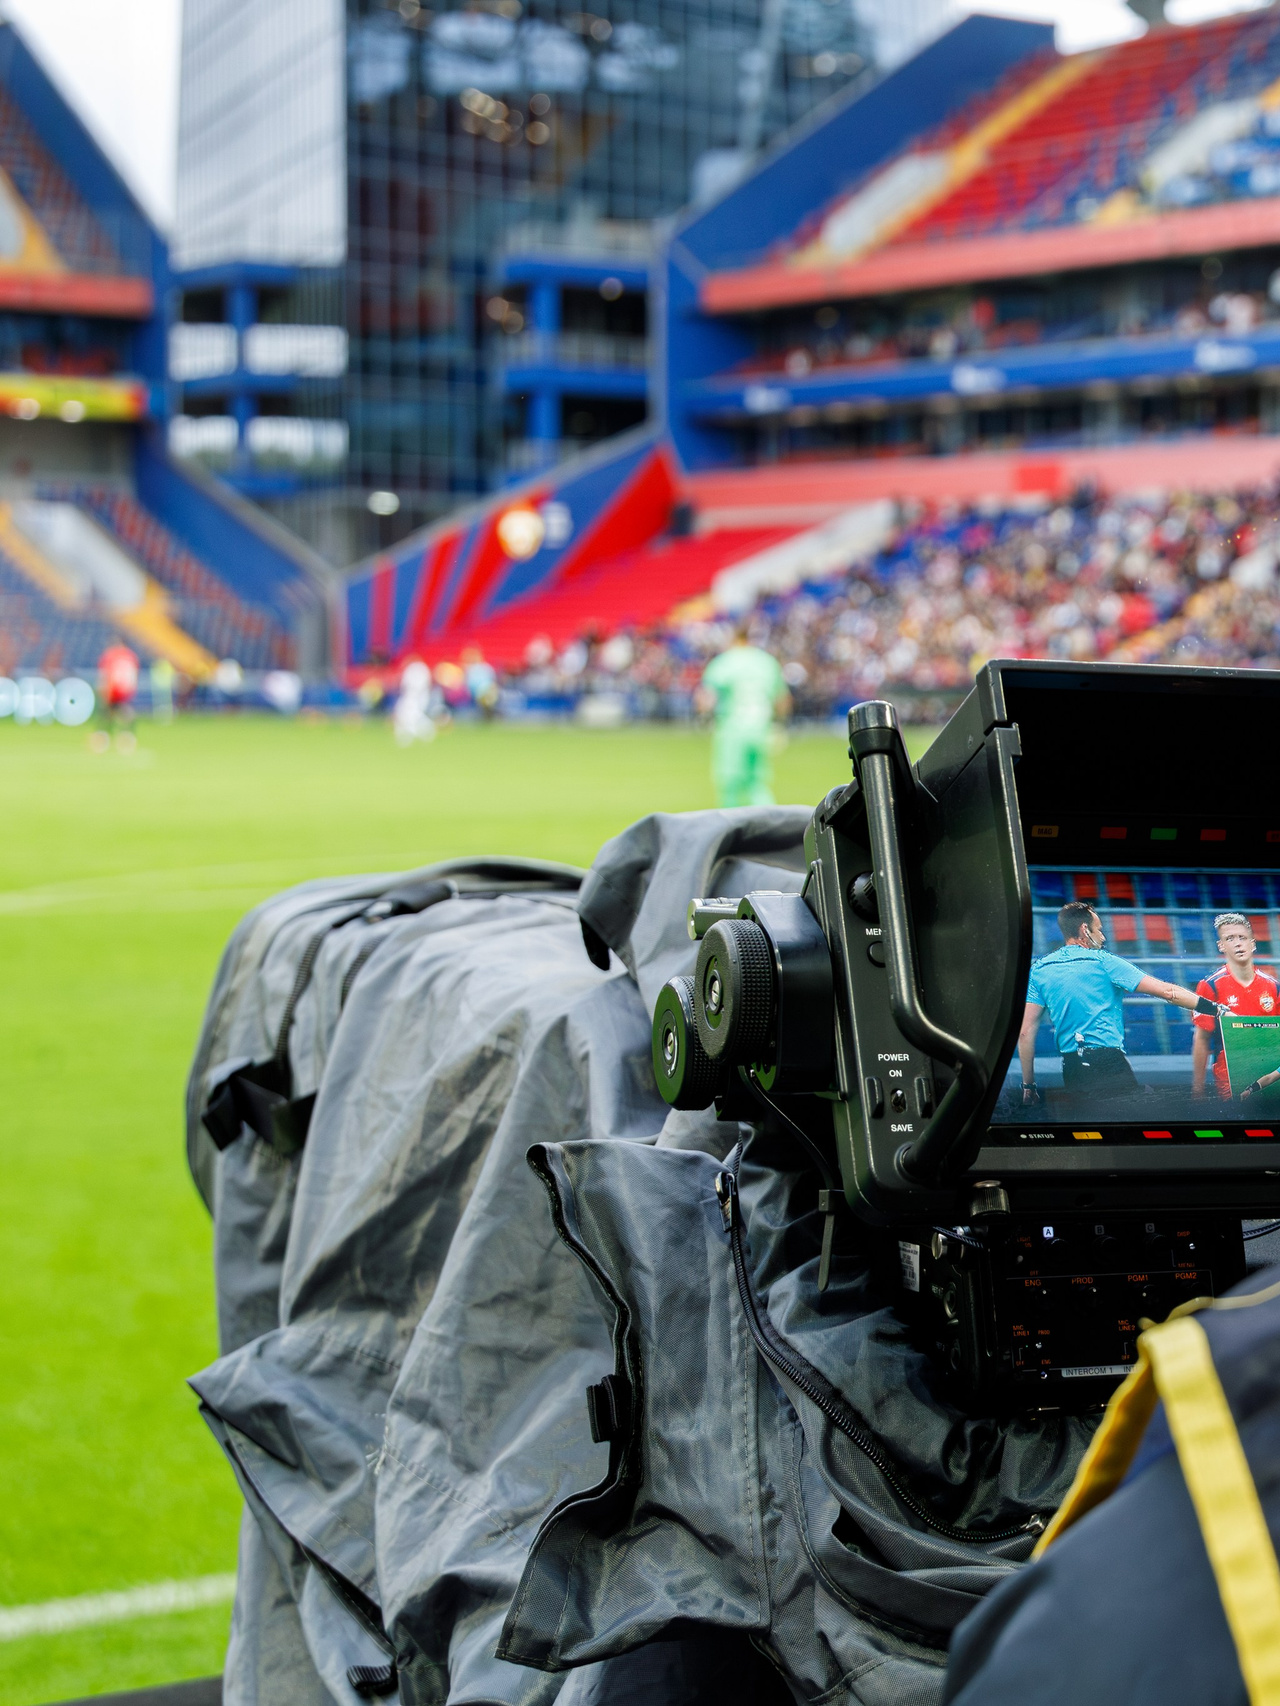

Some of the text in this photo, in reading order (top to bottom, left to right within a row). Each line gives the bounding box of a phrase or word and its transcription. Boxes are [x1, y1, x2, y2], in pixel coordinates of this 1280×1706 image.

[877, 1053, 910, 1062] POWER
[889, 1069, 903, 1077] ON
[890, 1124, 913, 1132] SAVE
[1127, 1274, 1149, 1282] PGM1
[1175, 1271, 1197, 1280] PGM2
[1024, 1279, 1042, 1287] ENG
[1071, 1276, 1094, 1285] PROD
[1065, 1367, 1107, 1376] INTERCOM
